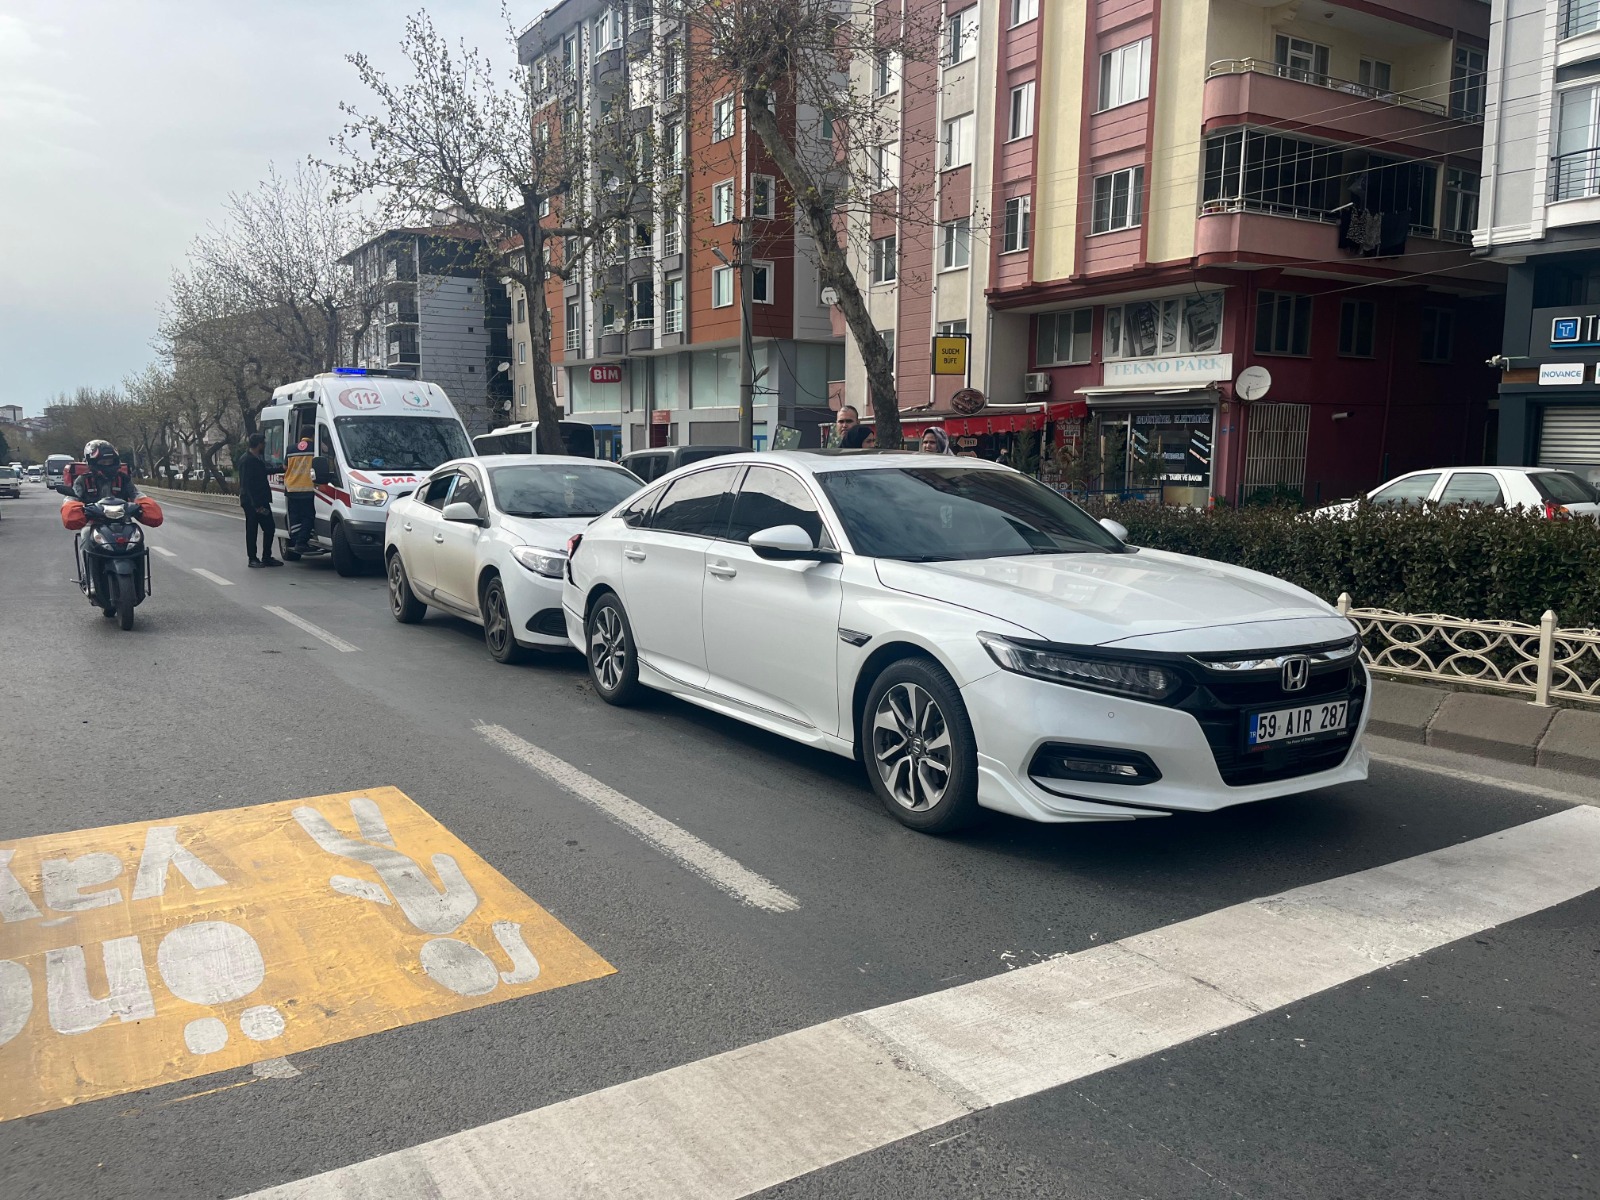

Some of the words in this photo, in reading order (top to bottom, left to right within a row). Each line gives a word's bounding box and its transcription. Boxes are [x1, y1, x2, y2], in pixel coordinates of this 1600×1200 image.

[593, 367, 618, 380] BİM
[1112, 361, 1170, 376] TEKNO
[1175, 358, 1222, 372] PARK
[1541, 370, 1582, 378] INOVANCE
[354, 392, 381, 405] 112
[1258, 714, 1277, 740] 59
[1285, 708, 1312, 736] AIR
[1320, 702, 1346, 730] 287
